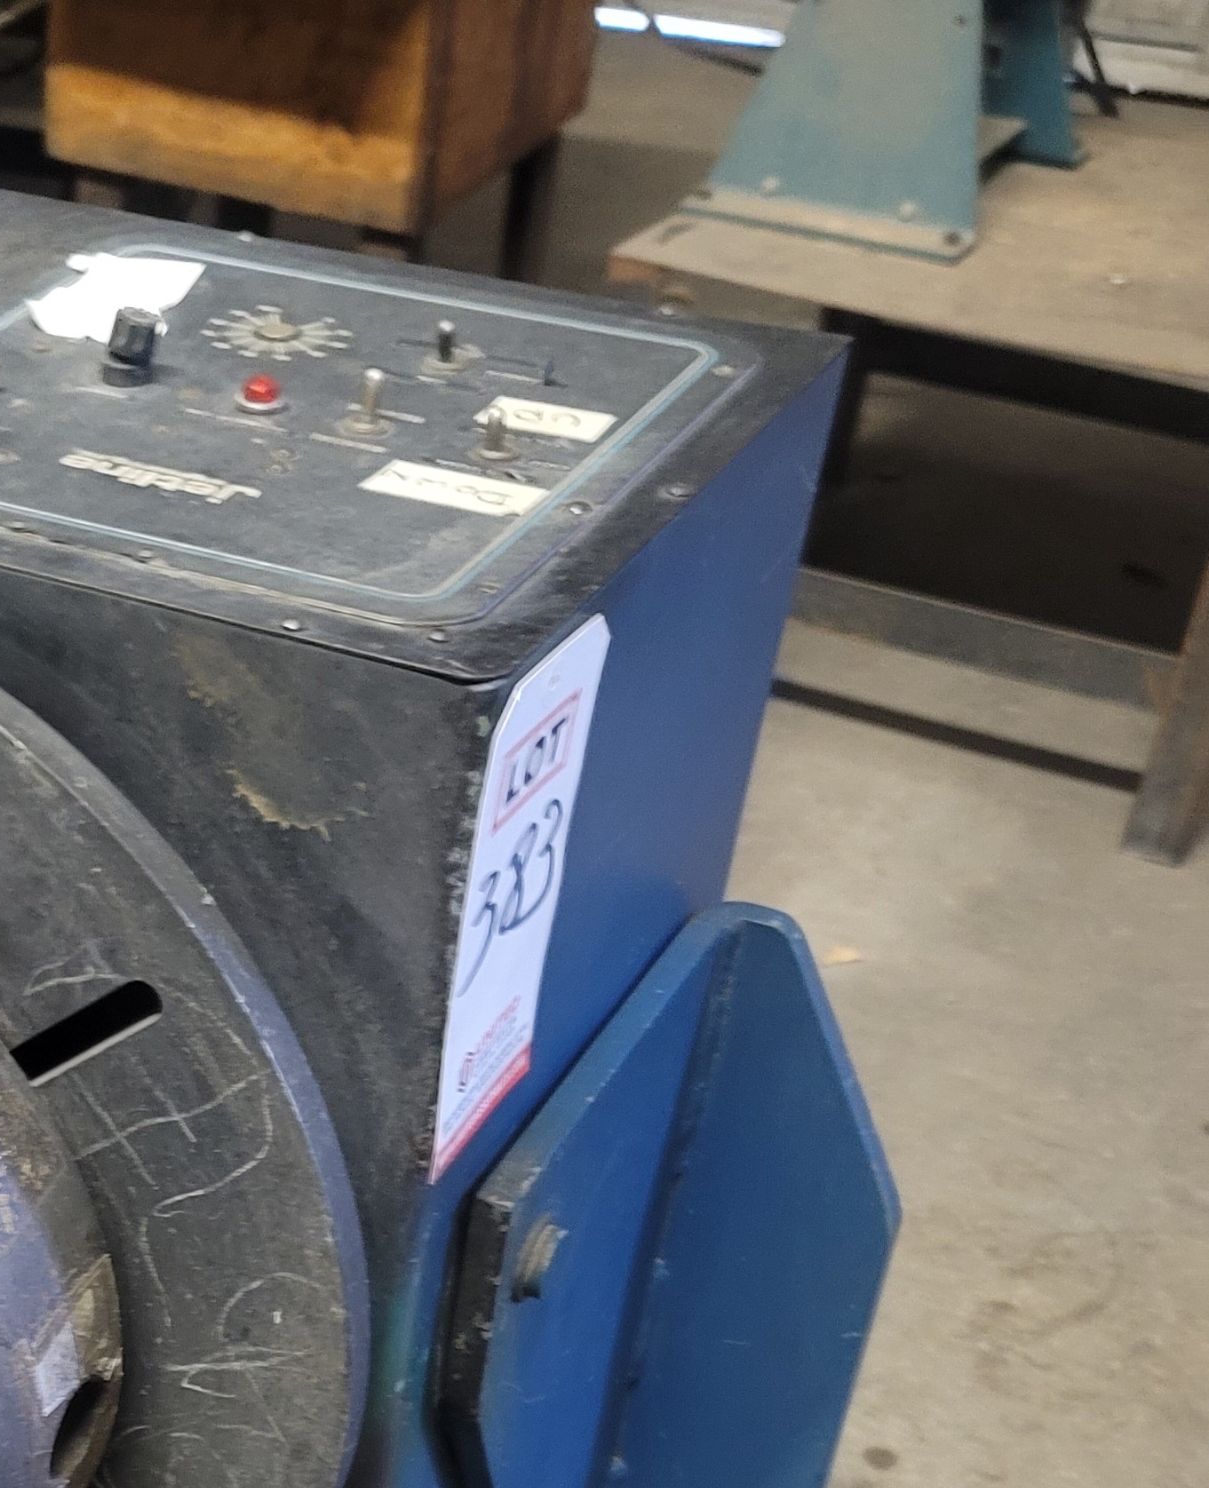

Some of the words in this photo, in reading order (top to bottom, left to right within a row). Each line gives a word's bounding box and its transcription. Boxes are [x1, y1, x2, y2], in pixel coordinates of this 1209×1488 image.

[58, 452, 263, 504] Jetline
[506, 717, 568, 803] LOT
[456, 798, 563, 997] 383
